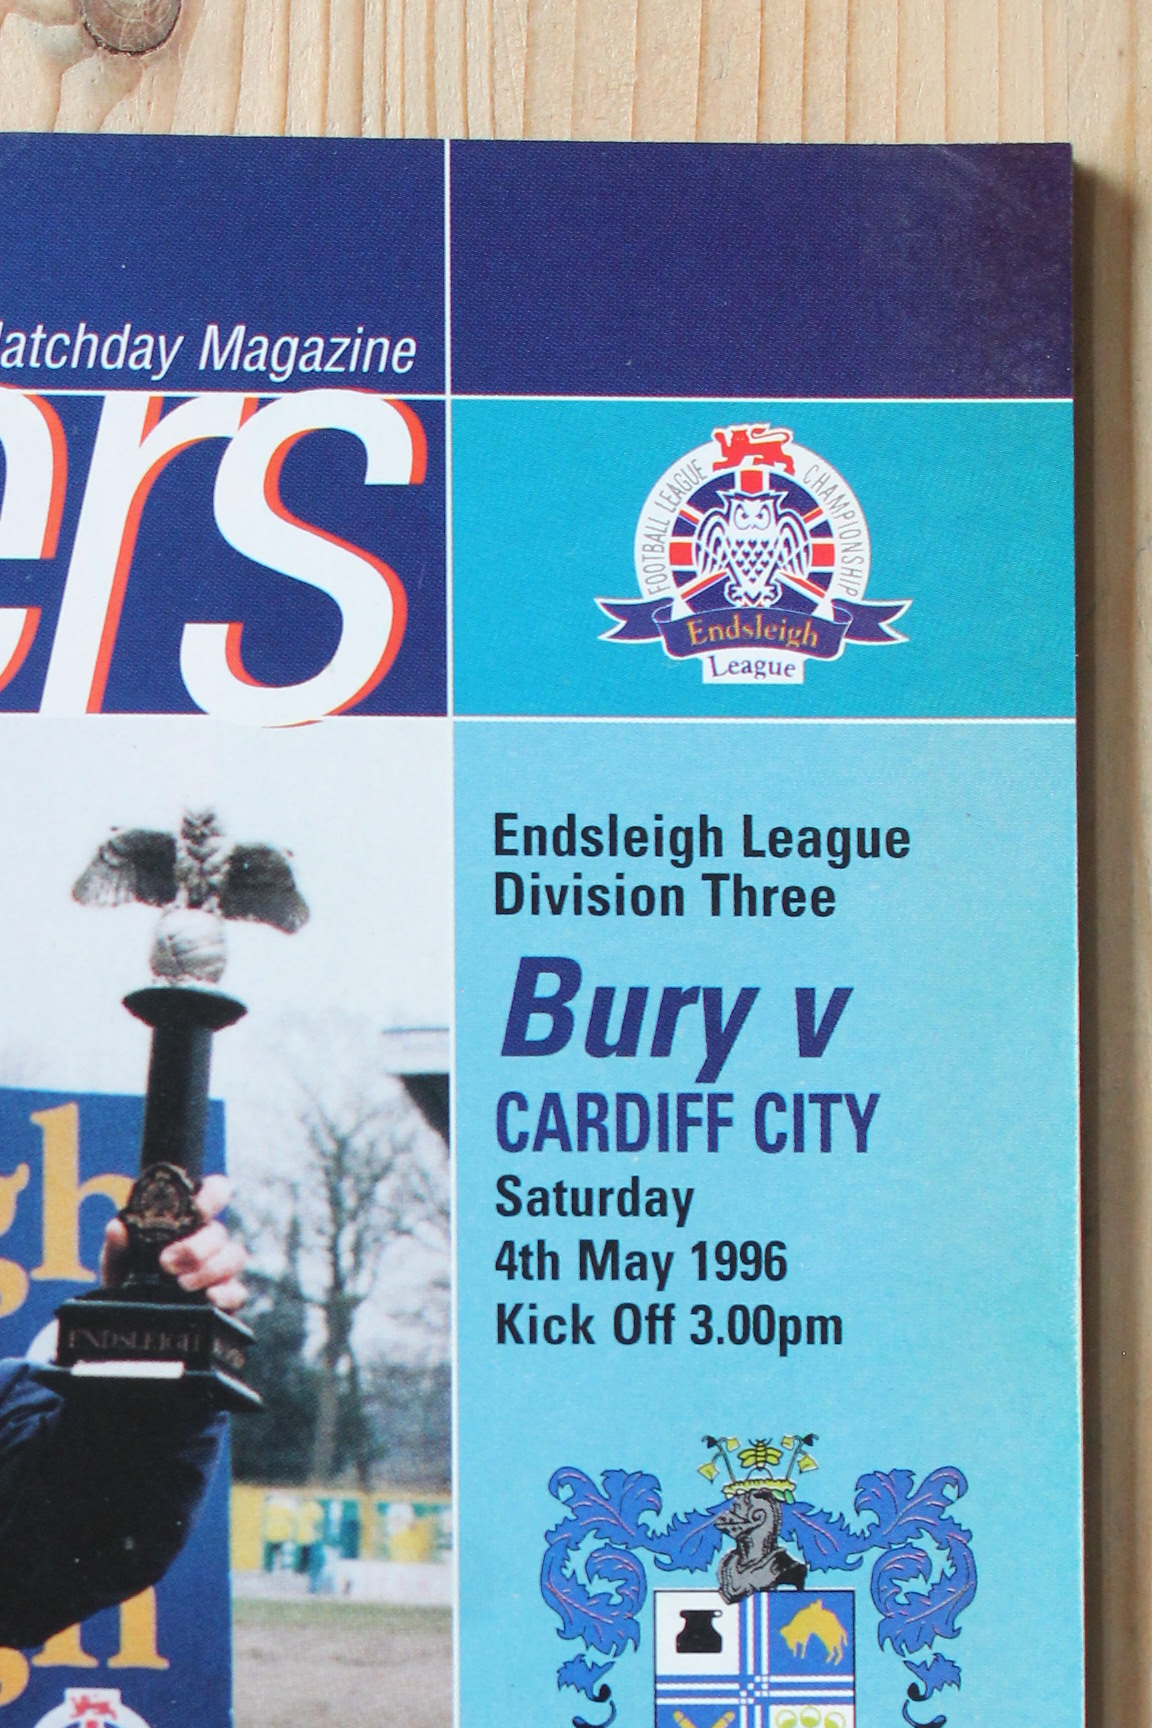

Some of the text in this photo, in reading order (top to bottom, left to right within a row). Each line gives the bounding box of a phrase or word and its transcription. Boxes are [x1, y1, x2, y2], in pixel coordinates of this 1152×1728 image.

[197, 325, 418, 382] Magazine
[640, 458, 709, 596] FOOTBALL LEAGUE
[801, 463, 865, 598] CHAMPIONSHIP
[687, 614, 819, 650] Endsleigh
[708, 655, 797, 680] League
[494, 813, 911, 869] Endsleigh League
[494, 871, 837, 917] Division Three
[500, 956, 854, 1084] Bury v
[496, 1091, 881, 1154] CARDIFF CITY
[496, 1174, 695, 1228] Saturday
[495, 1239, 788, 1291] 4th May 1996
[496, 1302, 843, 1357] Kick Off 3.00pm
